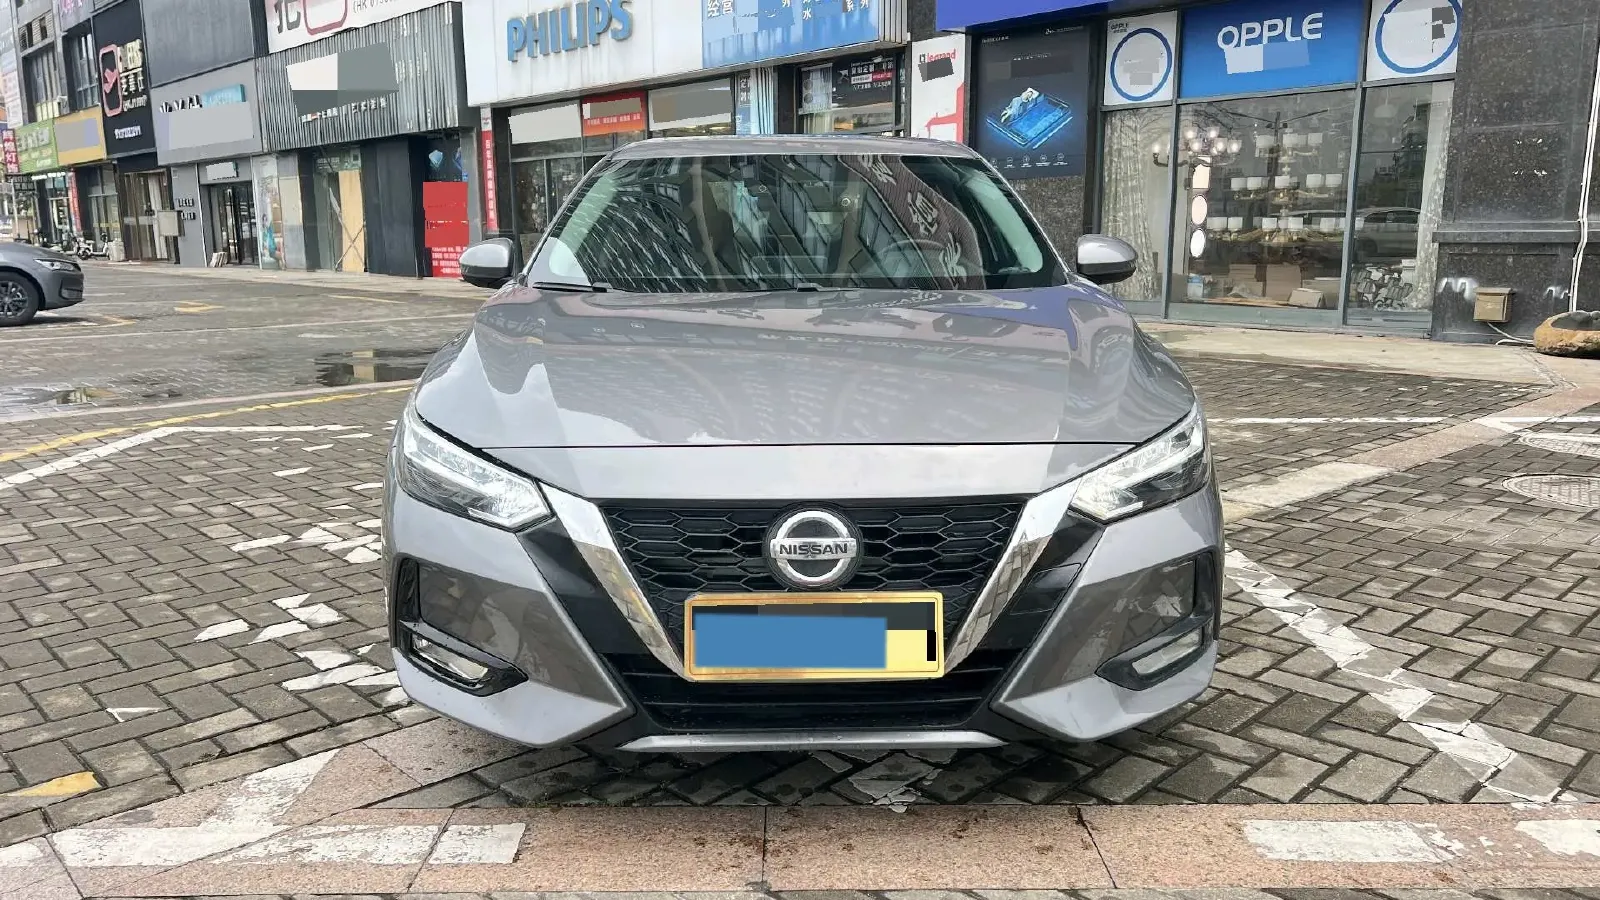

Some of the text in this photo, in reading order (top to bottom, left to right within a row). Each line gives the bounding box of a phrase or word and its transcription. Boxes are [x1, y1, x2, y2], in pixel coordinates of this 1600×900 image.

[507, 0, 633, 62] PHILIPS
[1217, 12, 1324, 50] OPPLE
[779, 542, 848, 555] NISSAN
